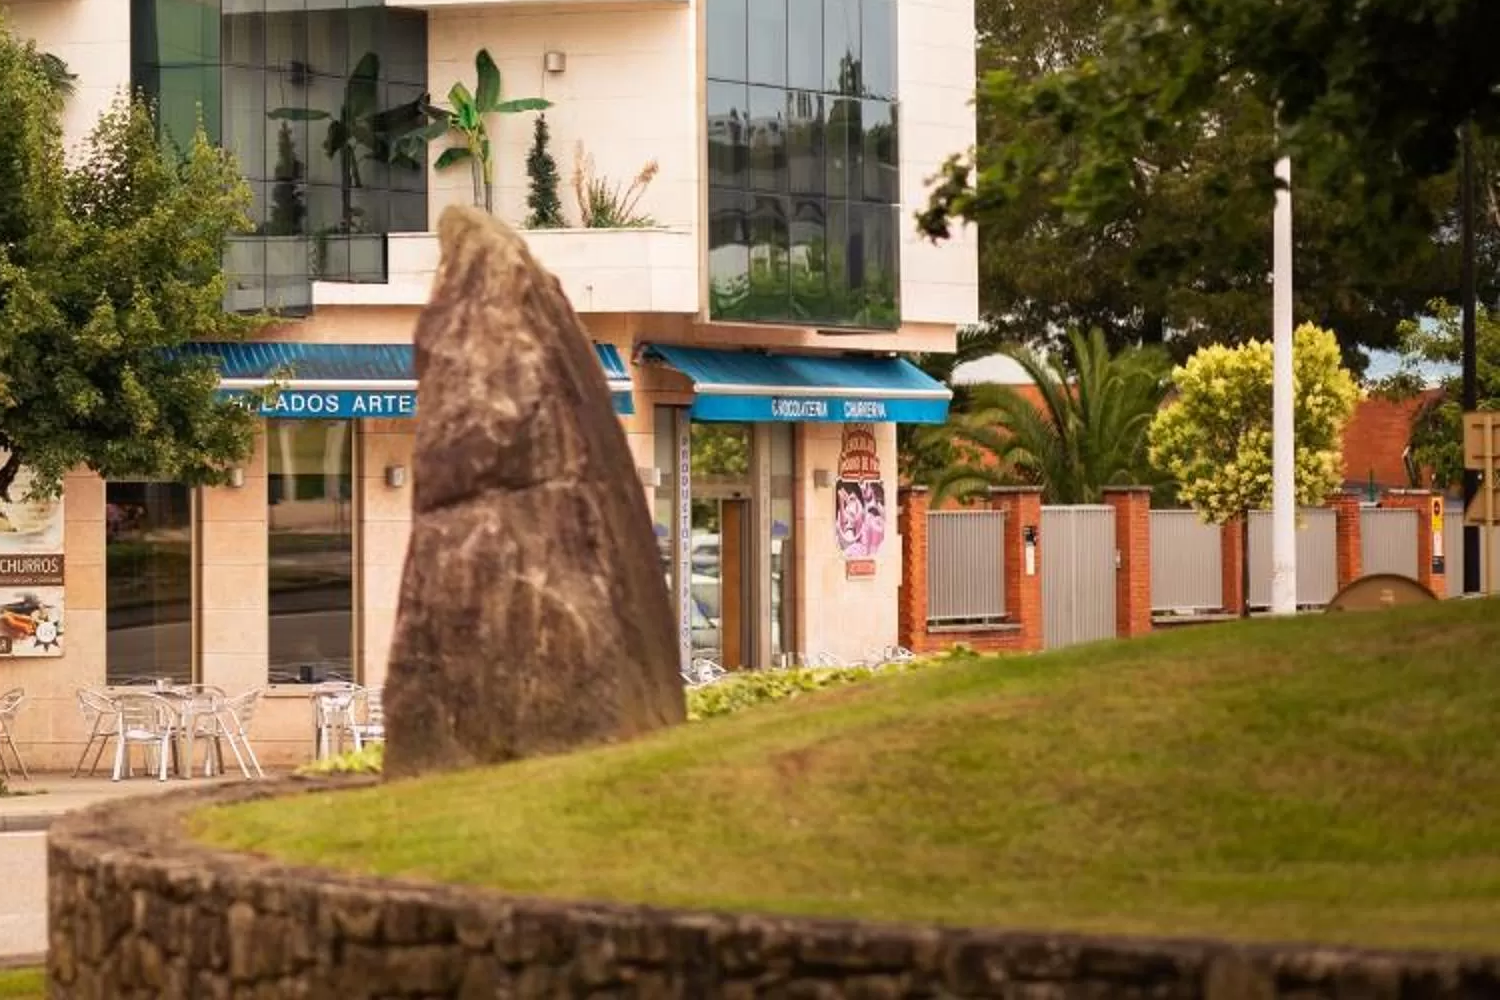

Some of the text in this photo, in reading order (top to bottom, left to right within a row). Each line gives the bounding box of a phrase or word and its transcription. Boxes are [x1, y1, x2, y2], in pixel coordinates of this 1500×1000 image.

[227, 394, 419, 413] LADOS ARTE
[0, 558, 59, 574] CHURROS
